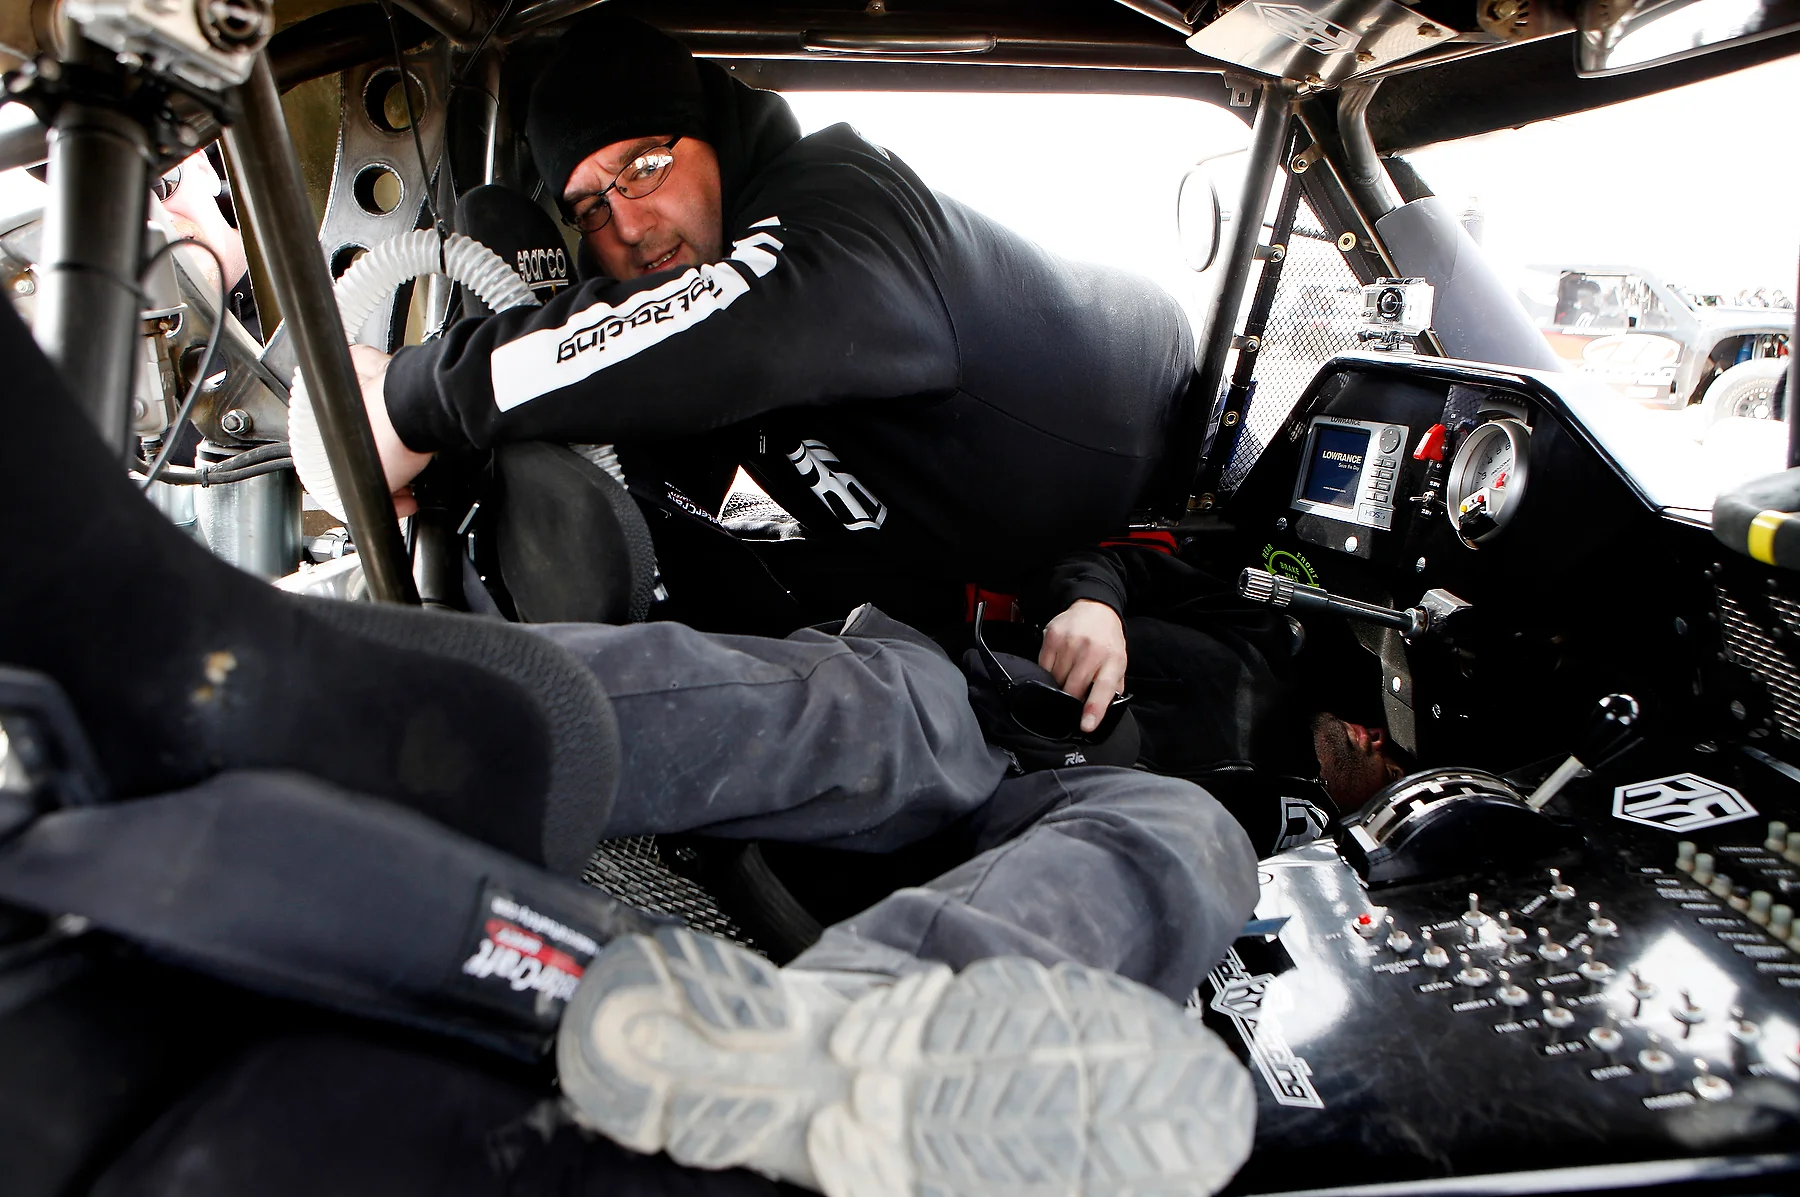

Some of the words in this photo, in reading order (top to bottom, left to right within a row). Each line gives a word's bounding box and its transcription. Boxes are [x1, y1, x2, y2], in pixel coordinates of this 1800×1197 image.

[556, 302, 675, 364] Racing
[1330, 416, 1361, 427] LOWRANCE
[1322, 450, 1363, 464] LOWRANCE
[1261, 543, 1274, 560] REAR
[1280, 561, 1300, 576] BRAKE
[1296, 551, 1319, 579] FRONT
